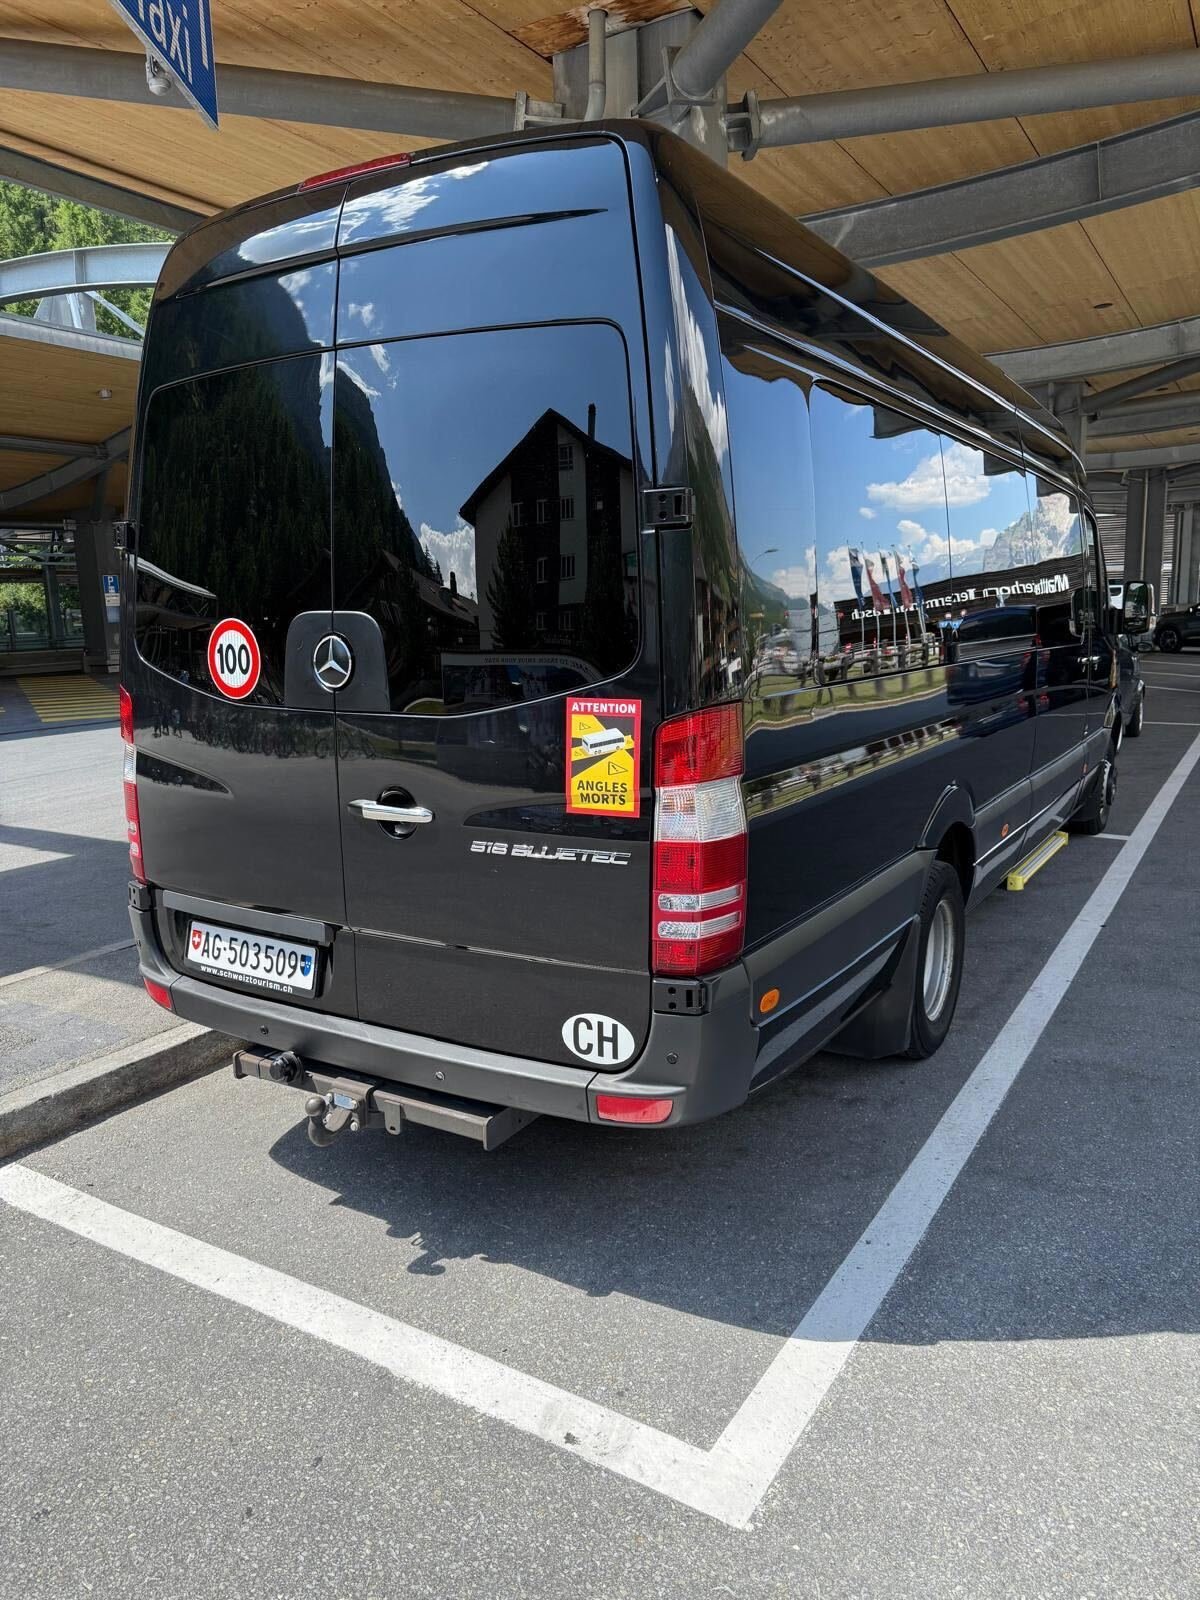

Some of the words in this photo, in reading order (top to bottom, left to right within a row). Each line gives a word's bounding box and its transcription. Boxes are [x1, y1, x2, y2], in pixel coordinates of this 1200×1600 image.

[217, 643, 251, 676] 100
[571, 702, 636, 714] ATTENTION
[577, 780, 628, 793] ANGLES
[579, 792, 626, 806] MORTS
[511, 844, 632, 866] BLUETEC
[200, 964, 294, 994] www.schweiztourism.ch
[573, 1016, 619, 1060] CH
